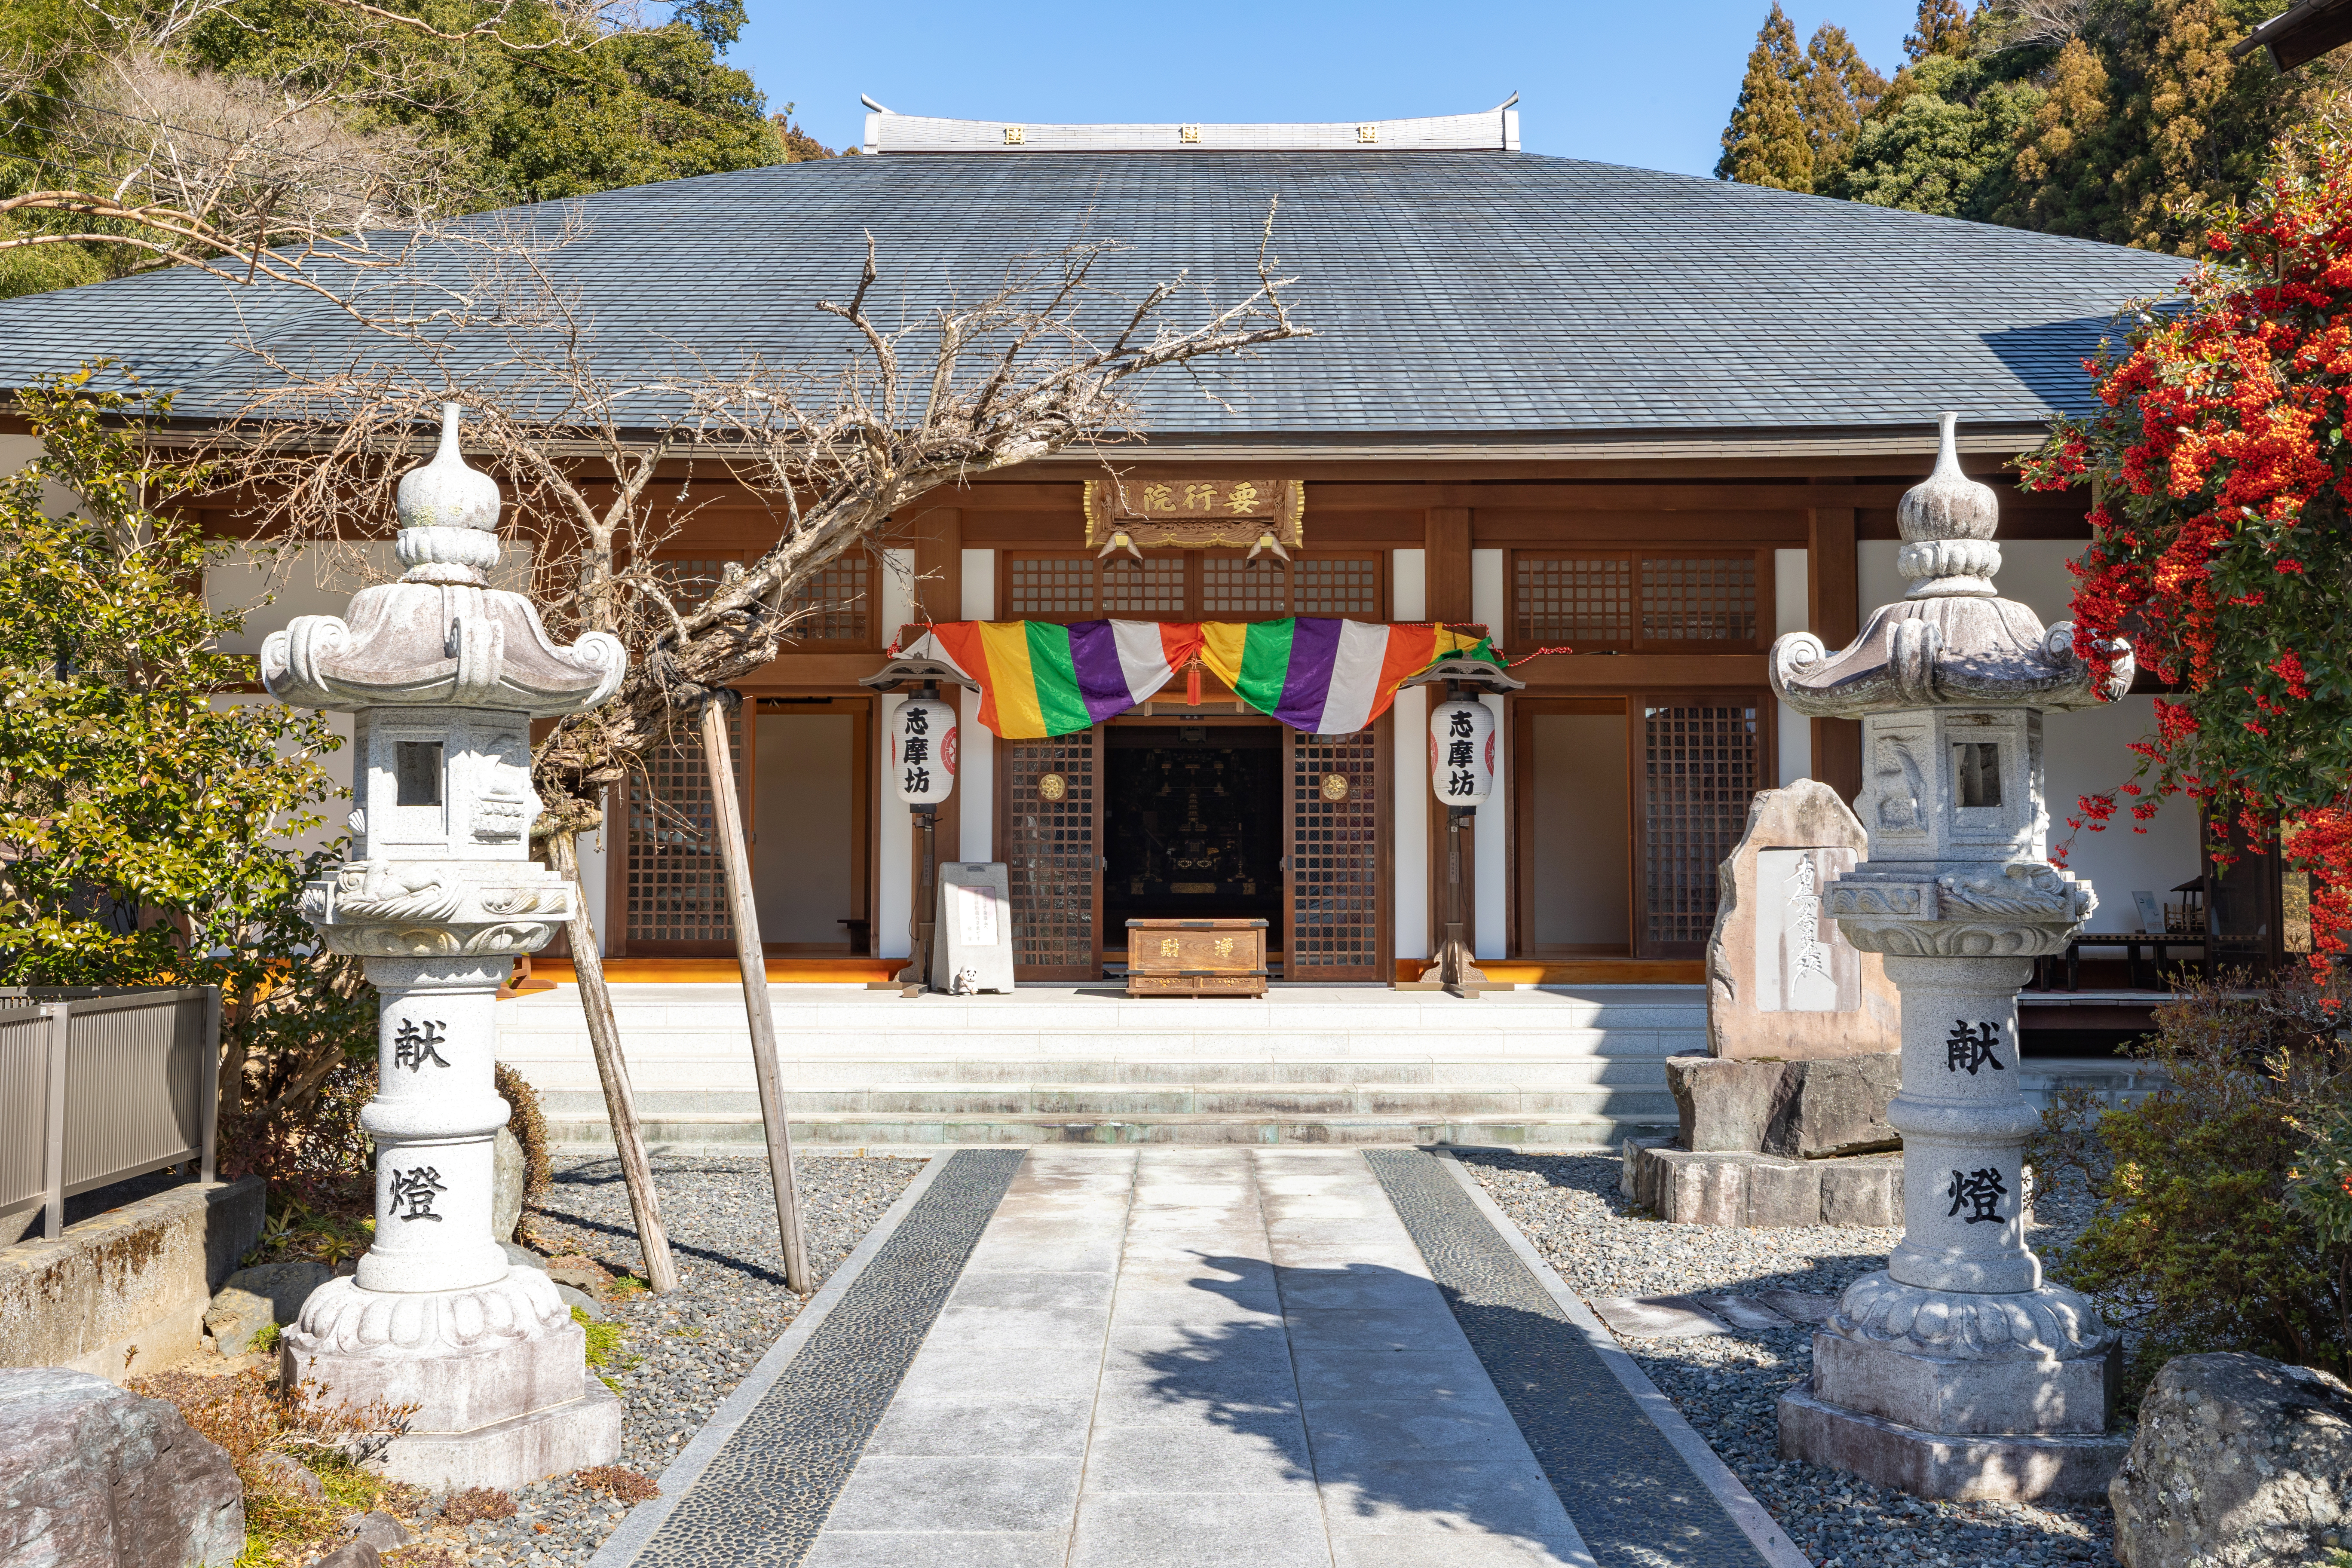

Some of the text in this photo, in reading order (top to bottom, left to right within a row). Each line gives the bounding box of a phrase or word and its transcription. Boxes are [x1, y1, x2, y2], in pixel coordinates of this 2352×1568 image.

[903, 707, 930, 793] 志摩坊
[1448, 710, 1475, 796] 志摩坊
